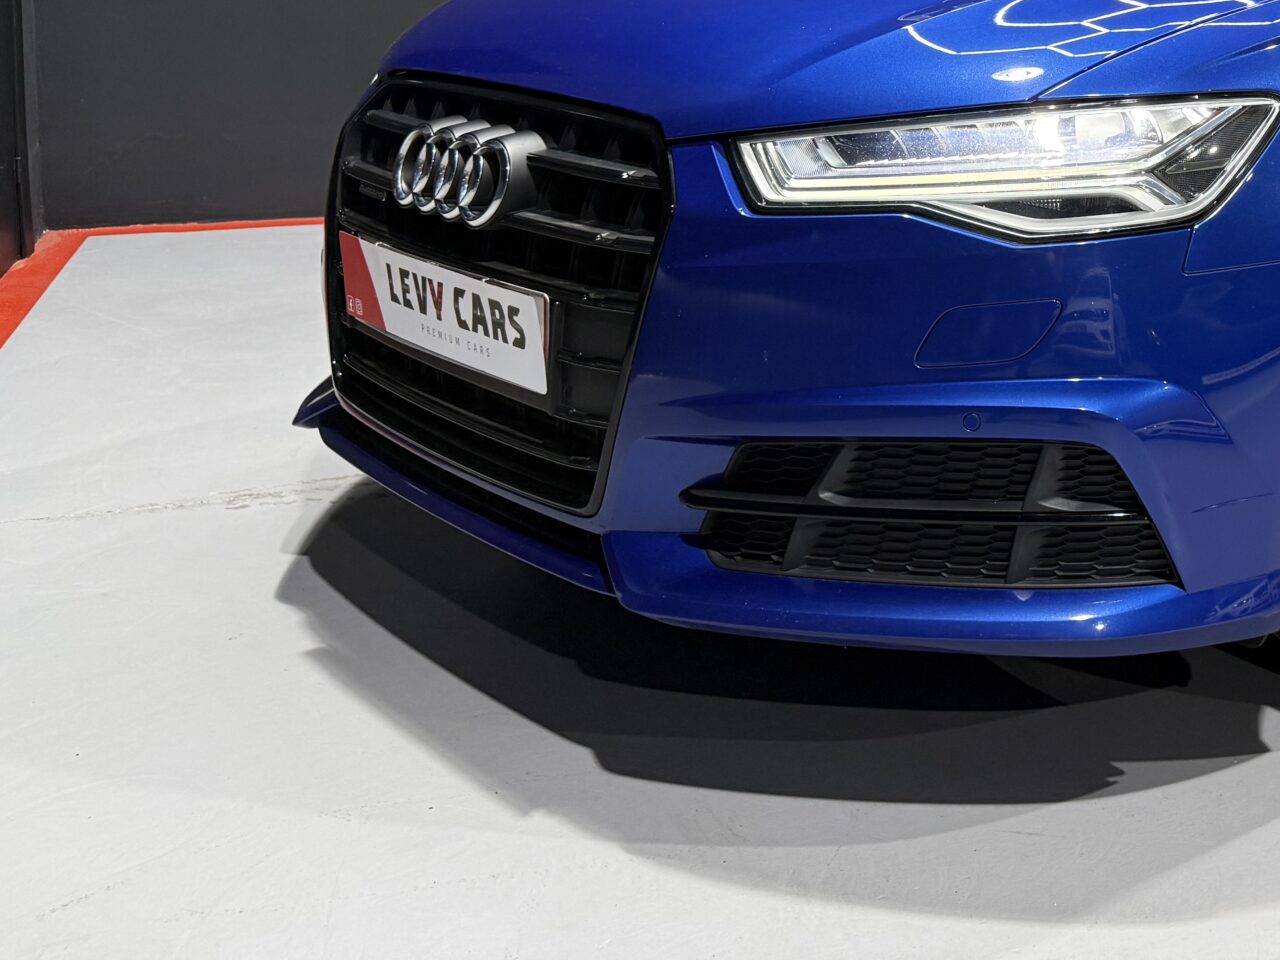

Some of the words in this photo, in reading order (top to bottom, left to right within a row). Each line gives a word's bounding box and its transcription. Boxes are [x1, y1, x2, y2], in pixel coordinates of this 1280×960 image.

[385, 262, 444, 322] LEVY
[453, 286, 526, 350] CARS
[420, 323, 461, 347] PREMIUM
[466, 340, 491, 358] CARS
